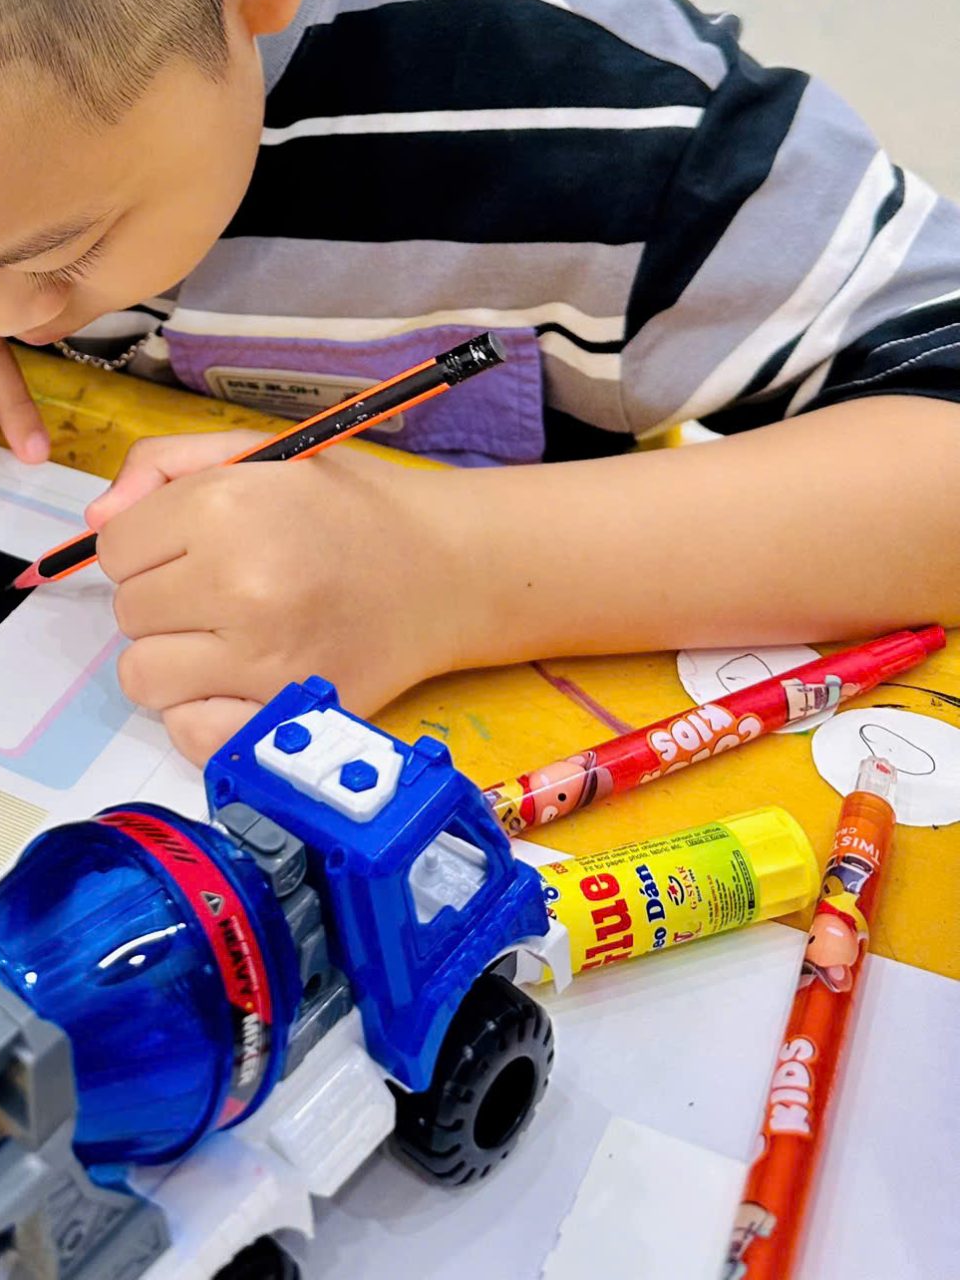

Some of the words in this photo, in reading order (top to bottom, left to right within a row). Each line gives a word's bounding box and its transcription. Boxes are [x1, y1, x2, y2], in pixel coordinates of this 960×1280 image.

[650, 703, 734, 762] KIDS
[635, 863, 665, 923] Dán
[653, 926, 667, 949] eo
[219, 917, 254, 996] HEAVY
[237, 1011, 261, 1088] MIXER
[769, 1037, 816, 1135] KIDS
